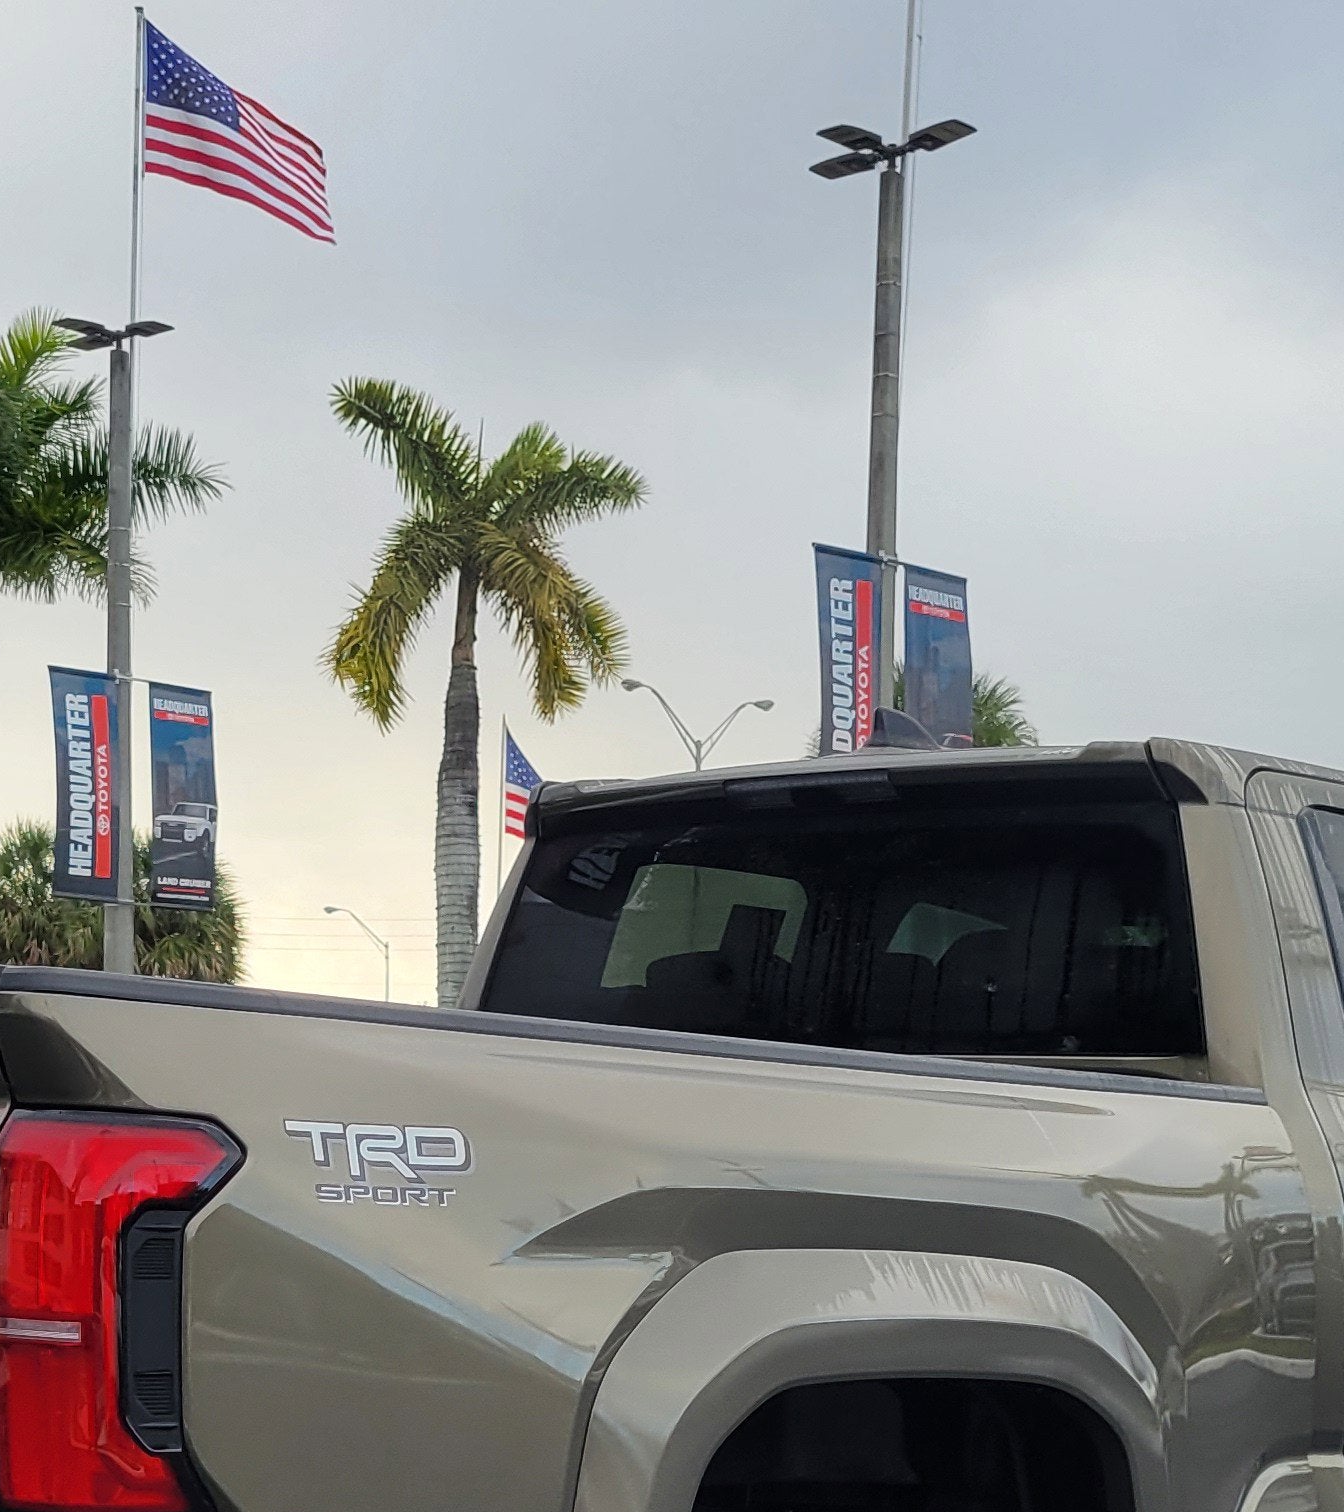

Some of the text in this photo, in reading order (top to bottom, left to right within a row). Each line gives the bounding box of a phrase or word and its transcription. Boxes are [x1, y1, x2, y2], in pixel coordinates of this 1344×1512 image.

[857, 645, 870, 734] TOYOTA
[65, 693, 95, 877] HEADQUARTER
[97, 744, 109, 813] TOYOTA
[283, 1119, 471, 1184] TRD
[315, 1184, 457, 1207] SPORT
